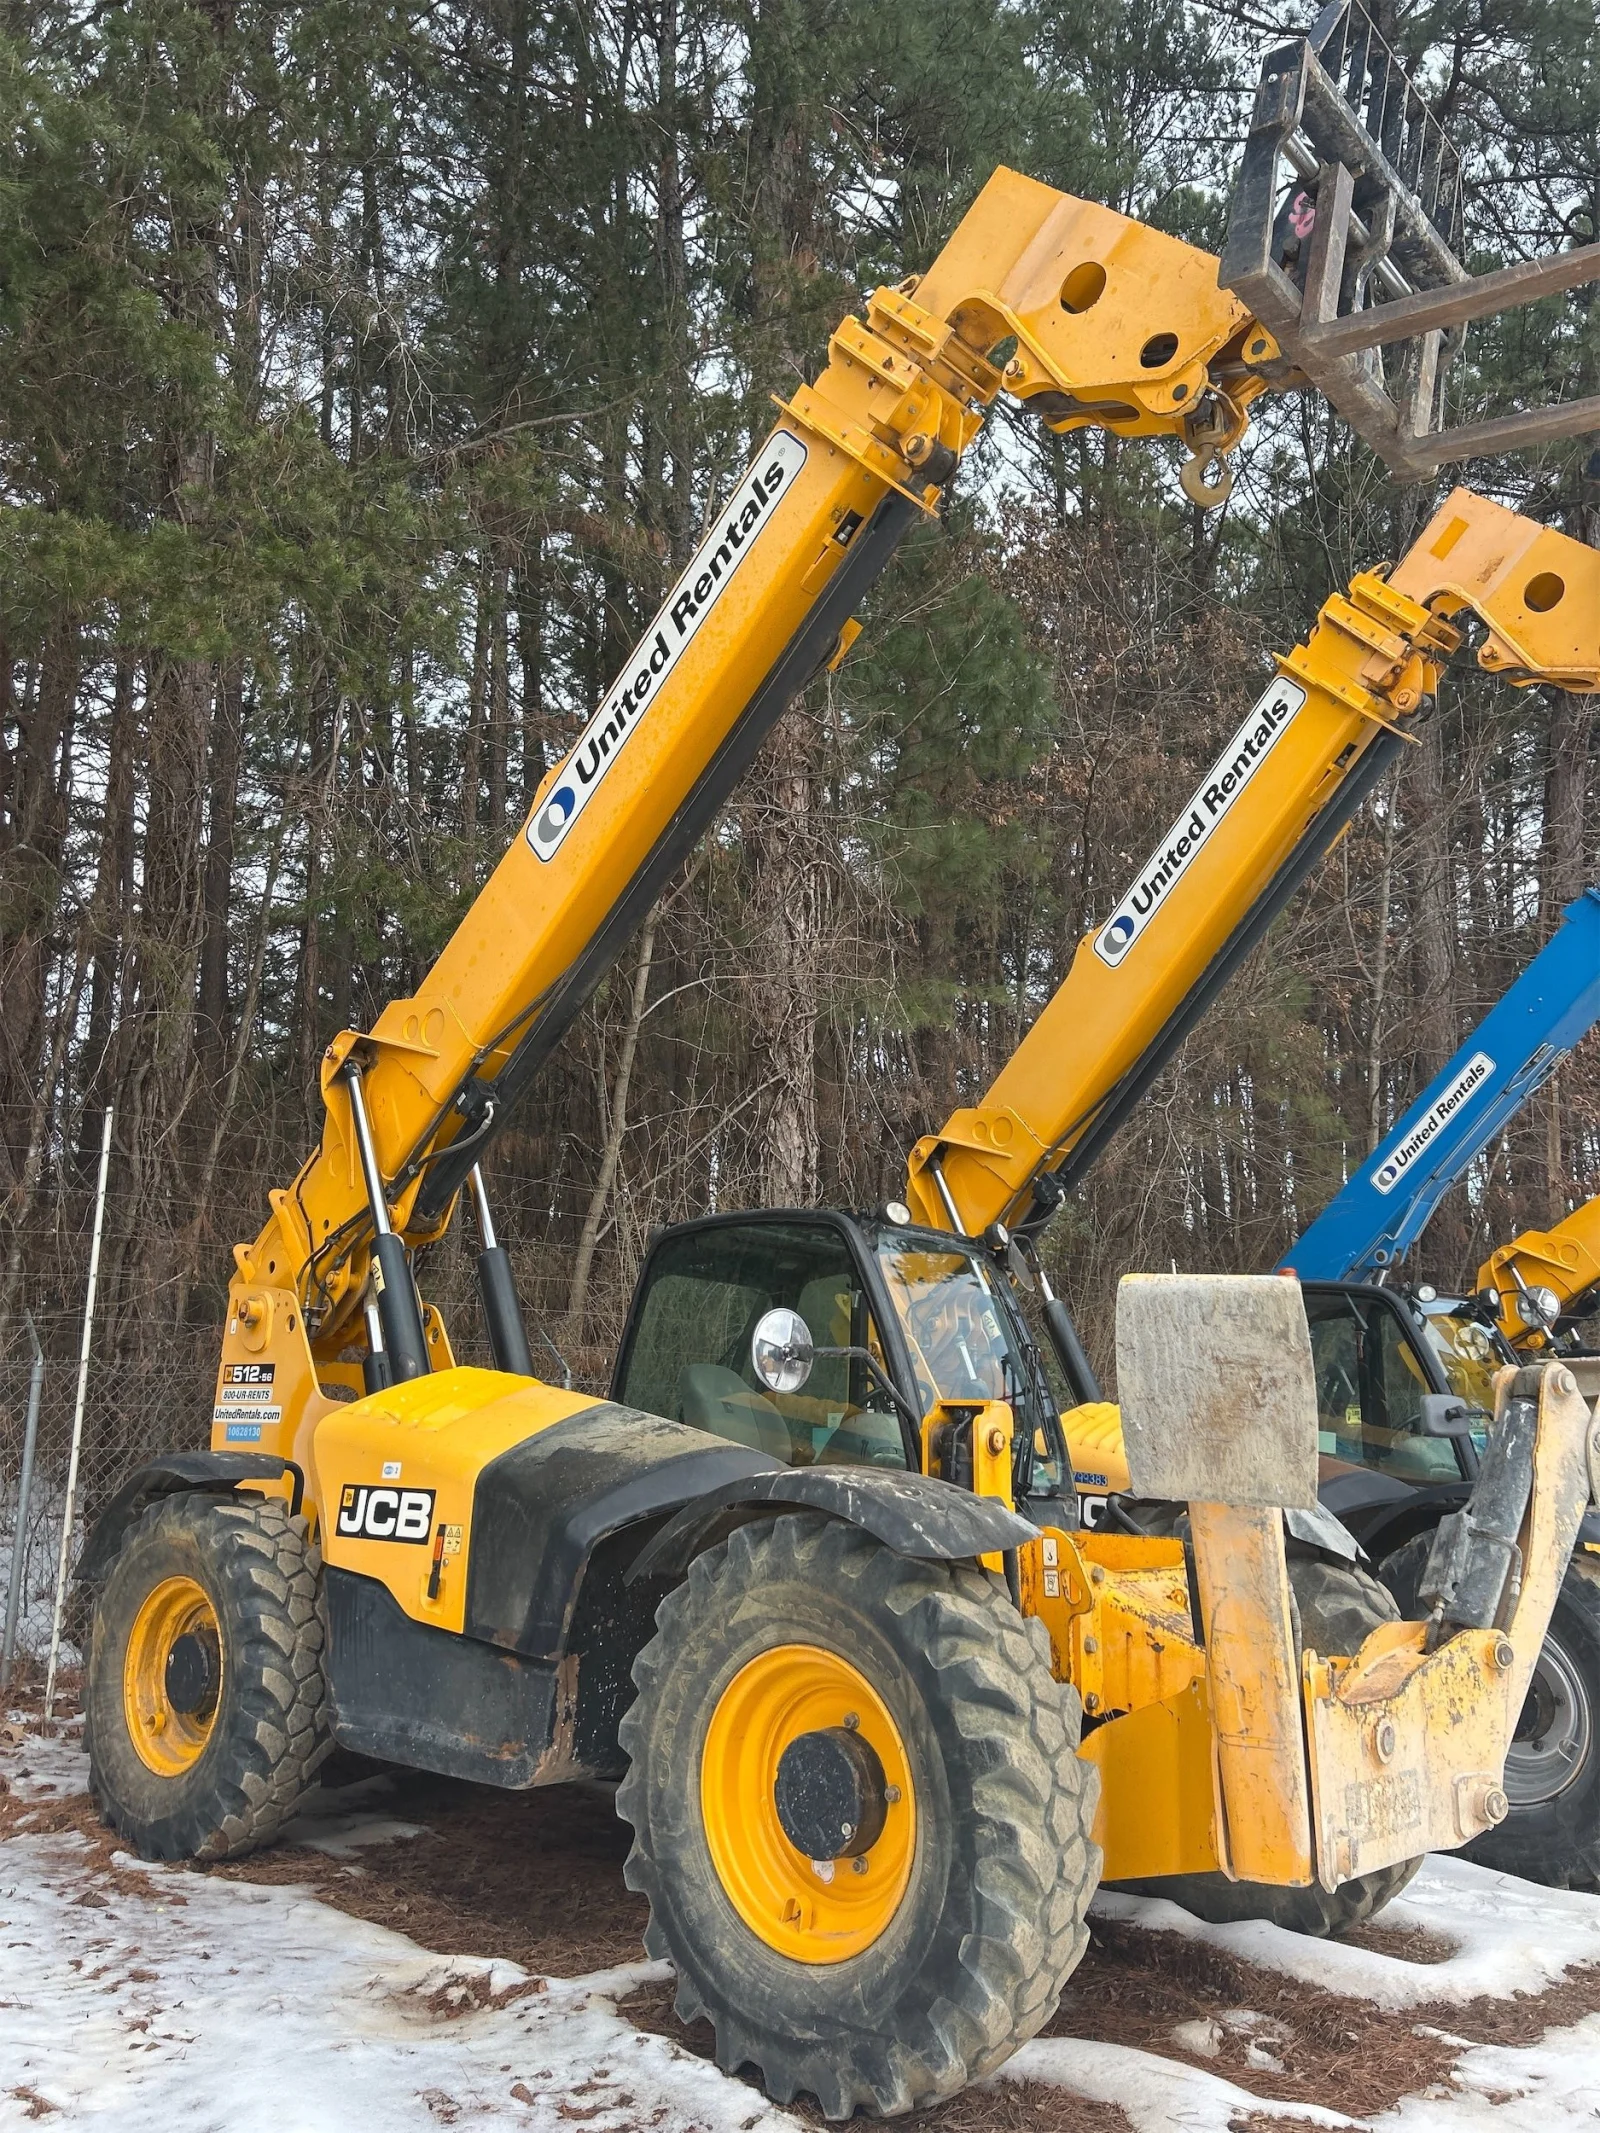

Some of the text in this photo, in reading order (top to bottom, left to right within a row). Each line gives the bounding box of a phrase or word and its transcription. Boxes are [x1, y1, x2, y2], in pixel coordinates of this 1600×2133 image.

[575, 460, 785, 784] United Rentals
[1131, 698, 1289, 915] United Rentals
[1394, 1063, 1485, 1168] United Rentals
[214, 1408, 280, 1420] UnitedRentals.com
[223, 1390, 270, 1400] 800-UR-RENTS
[339, 1488, 432, 1540] JCB
